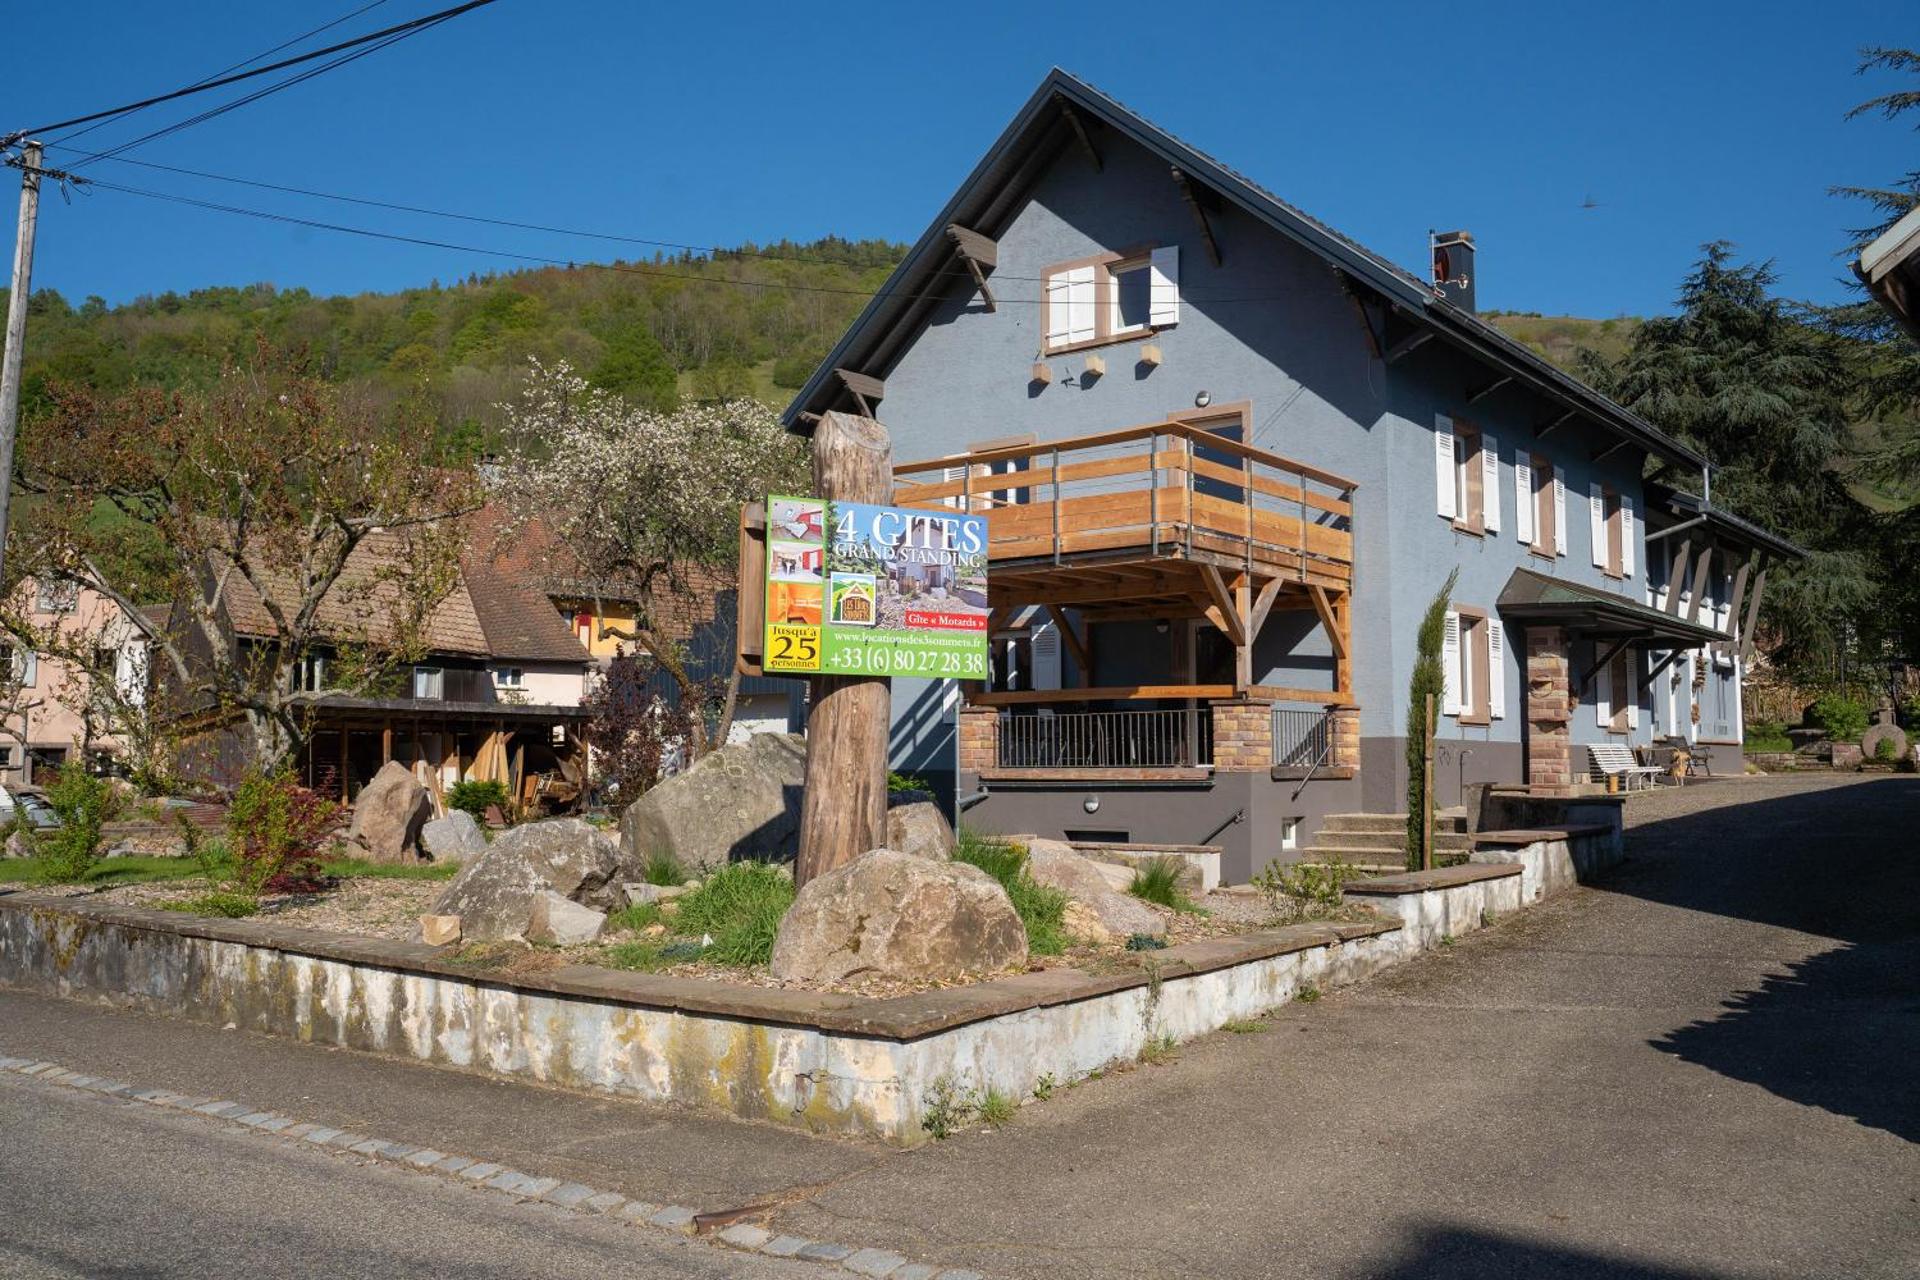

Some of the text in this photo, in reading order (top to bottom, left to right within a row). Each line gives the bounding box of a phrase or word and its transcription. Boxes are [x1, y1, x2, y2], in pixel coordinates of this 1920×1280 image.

[836, 510, 981, 554] 4 GITES
[835, 542, 980, 568] GRAND STANDING
[939, 616, 976, 627] Motards
[773, 636, 816, 660] 25
[831, 647, 983, 674] +33 (6) 80 27 28 38
[771, 660, 816, 669] personnes
